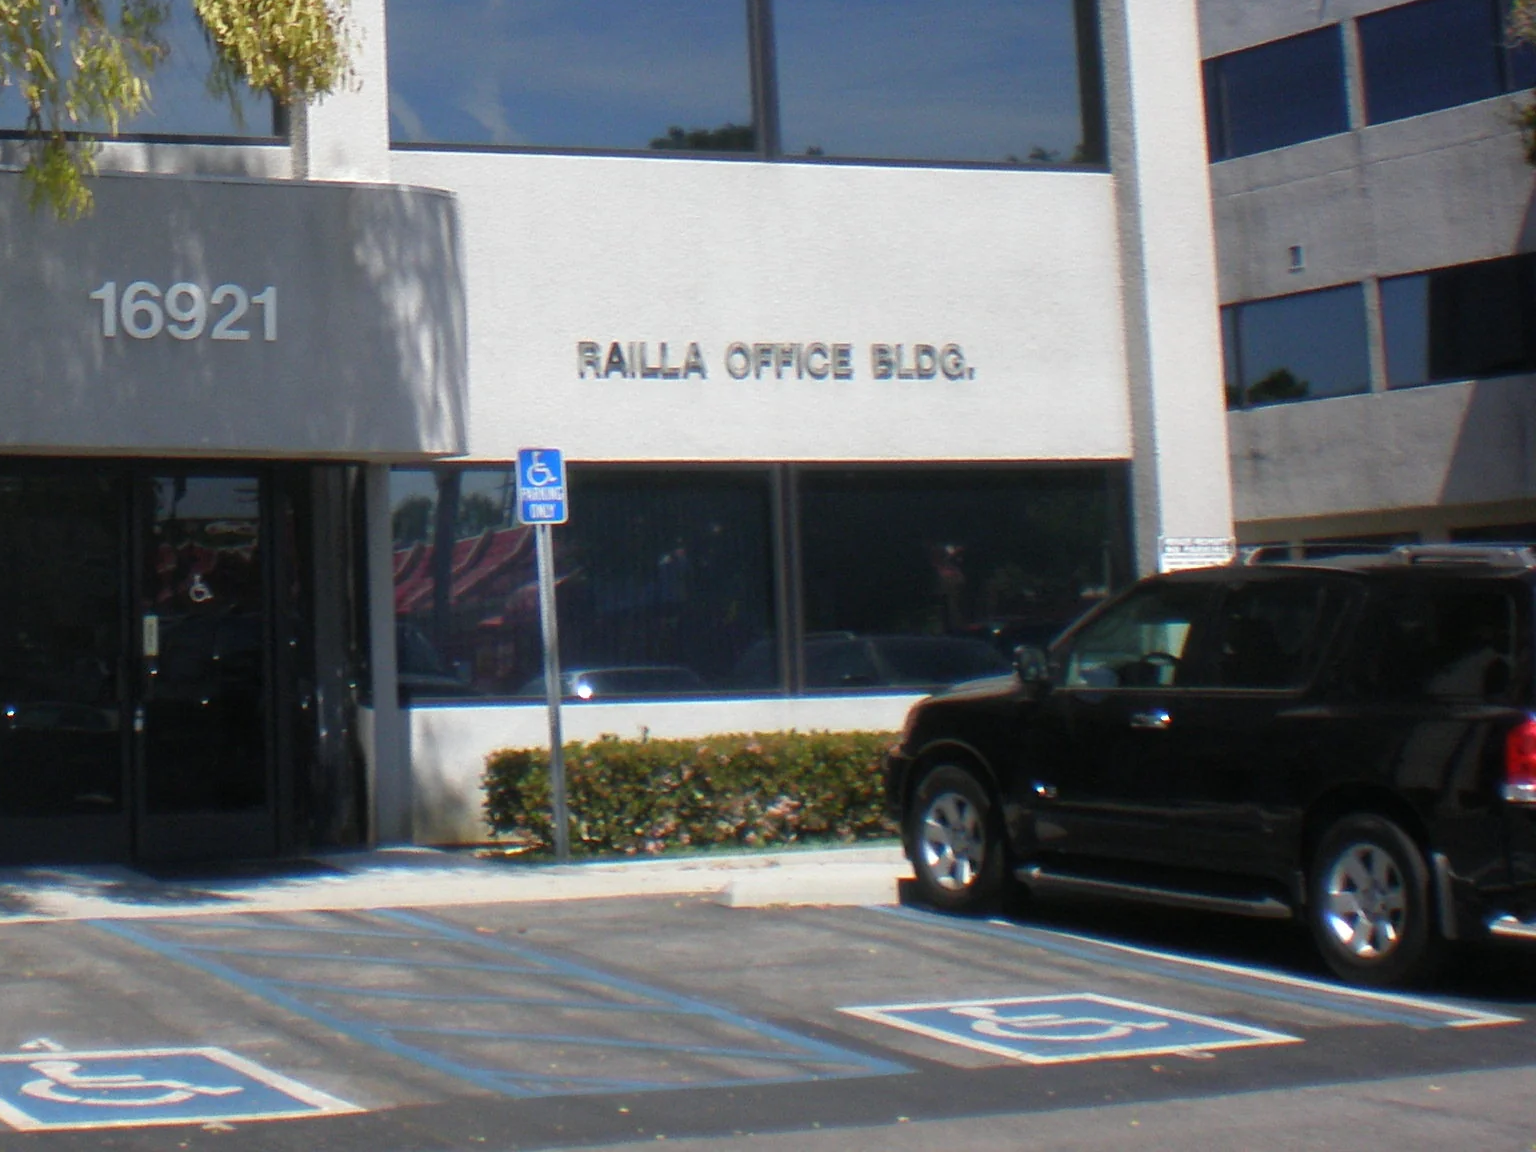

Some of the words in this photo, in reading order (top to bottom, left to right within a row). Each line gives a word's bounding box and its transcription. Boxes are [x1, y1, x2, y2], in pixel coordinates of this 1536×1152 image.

[89, 281, 277, 341] 16921
[577, 341, 707, 379] RAILLA
[724, 341, 854, 381] OFFICE
[869, 343, 976, 380] BLDG.
[528, 503, 556, 519] ONLY
